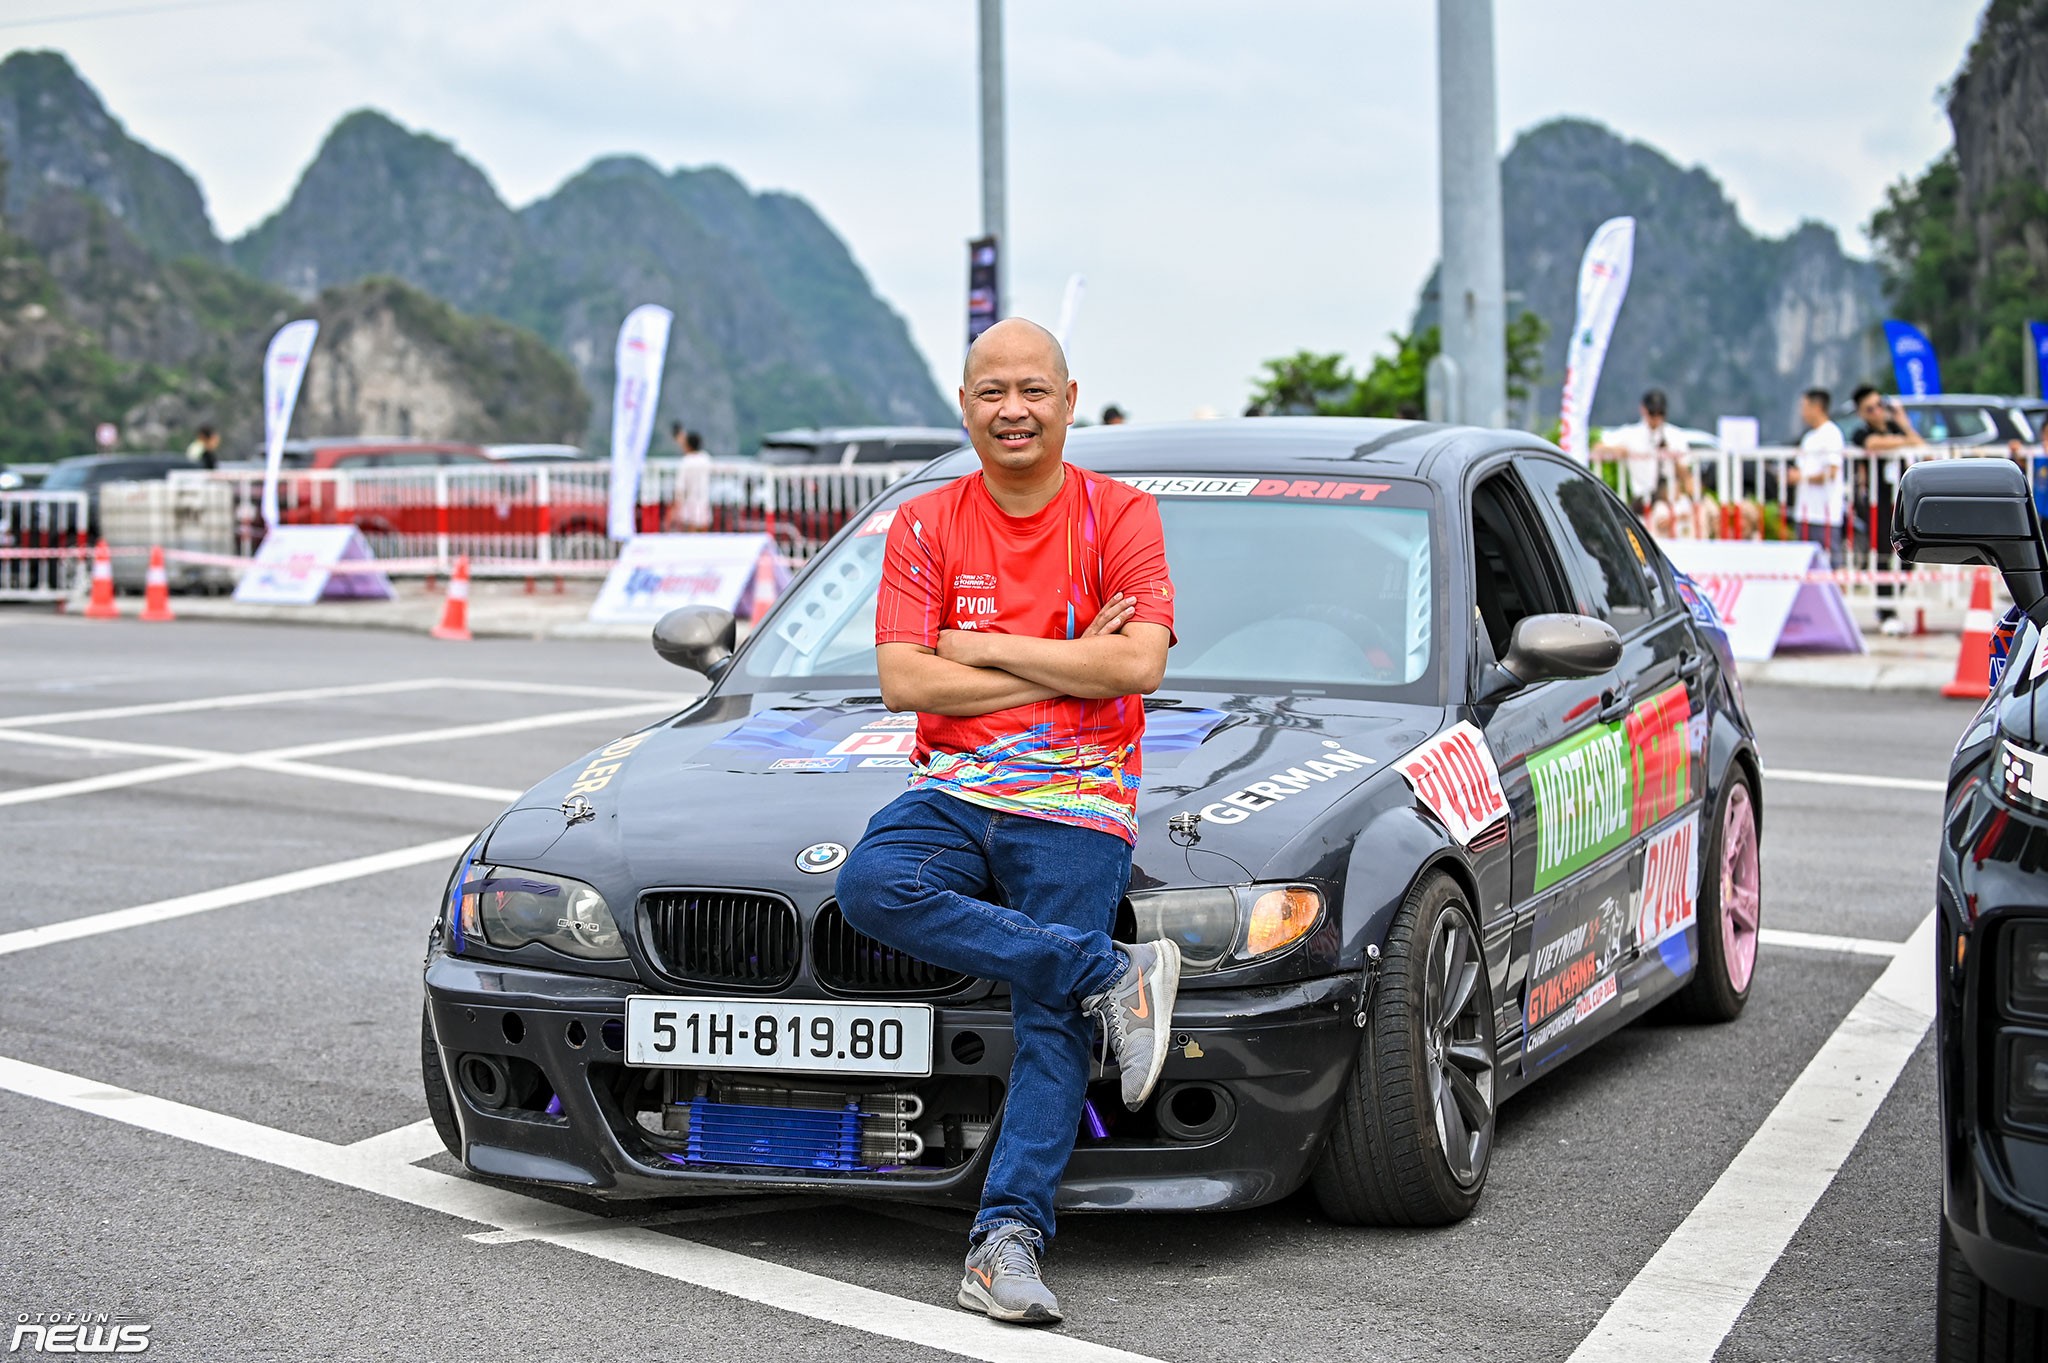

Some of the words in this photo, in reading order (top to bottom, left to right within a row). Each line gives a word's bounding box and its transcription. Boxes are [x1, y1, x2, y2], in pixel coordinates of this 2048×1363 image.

[1121, 480, 1249, 493] THSIDE
[1250, 479, 1391, 501] DRIFT
[956, 596, 998, 615] PVOIL
[565, 732, 652, 800] DLER
[1200, 748, 1377, 825] GERMAN
[1405, 731, 1503, 831] PVOIL
[1534, 731, 1627, 873] NORTHSIDE
[1625, 682, 1691, 838] DRIFT
[1640, 823, 1692, 945] PVOIL
[1533, 922, 1588, 980] VIETNAM
[1527, 1005, 1576, 1053] CHAMPIONSHIP
[1576, 996, 1592, 1020] PVOIL
[1592, 985, 1604, 1007] CUP
[1529, 951, 1596, 1024] GYMKHANA
[653, 1011, 903, 1060] 51H-819.80
